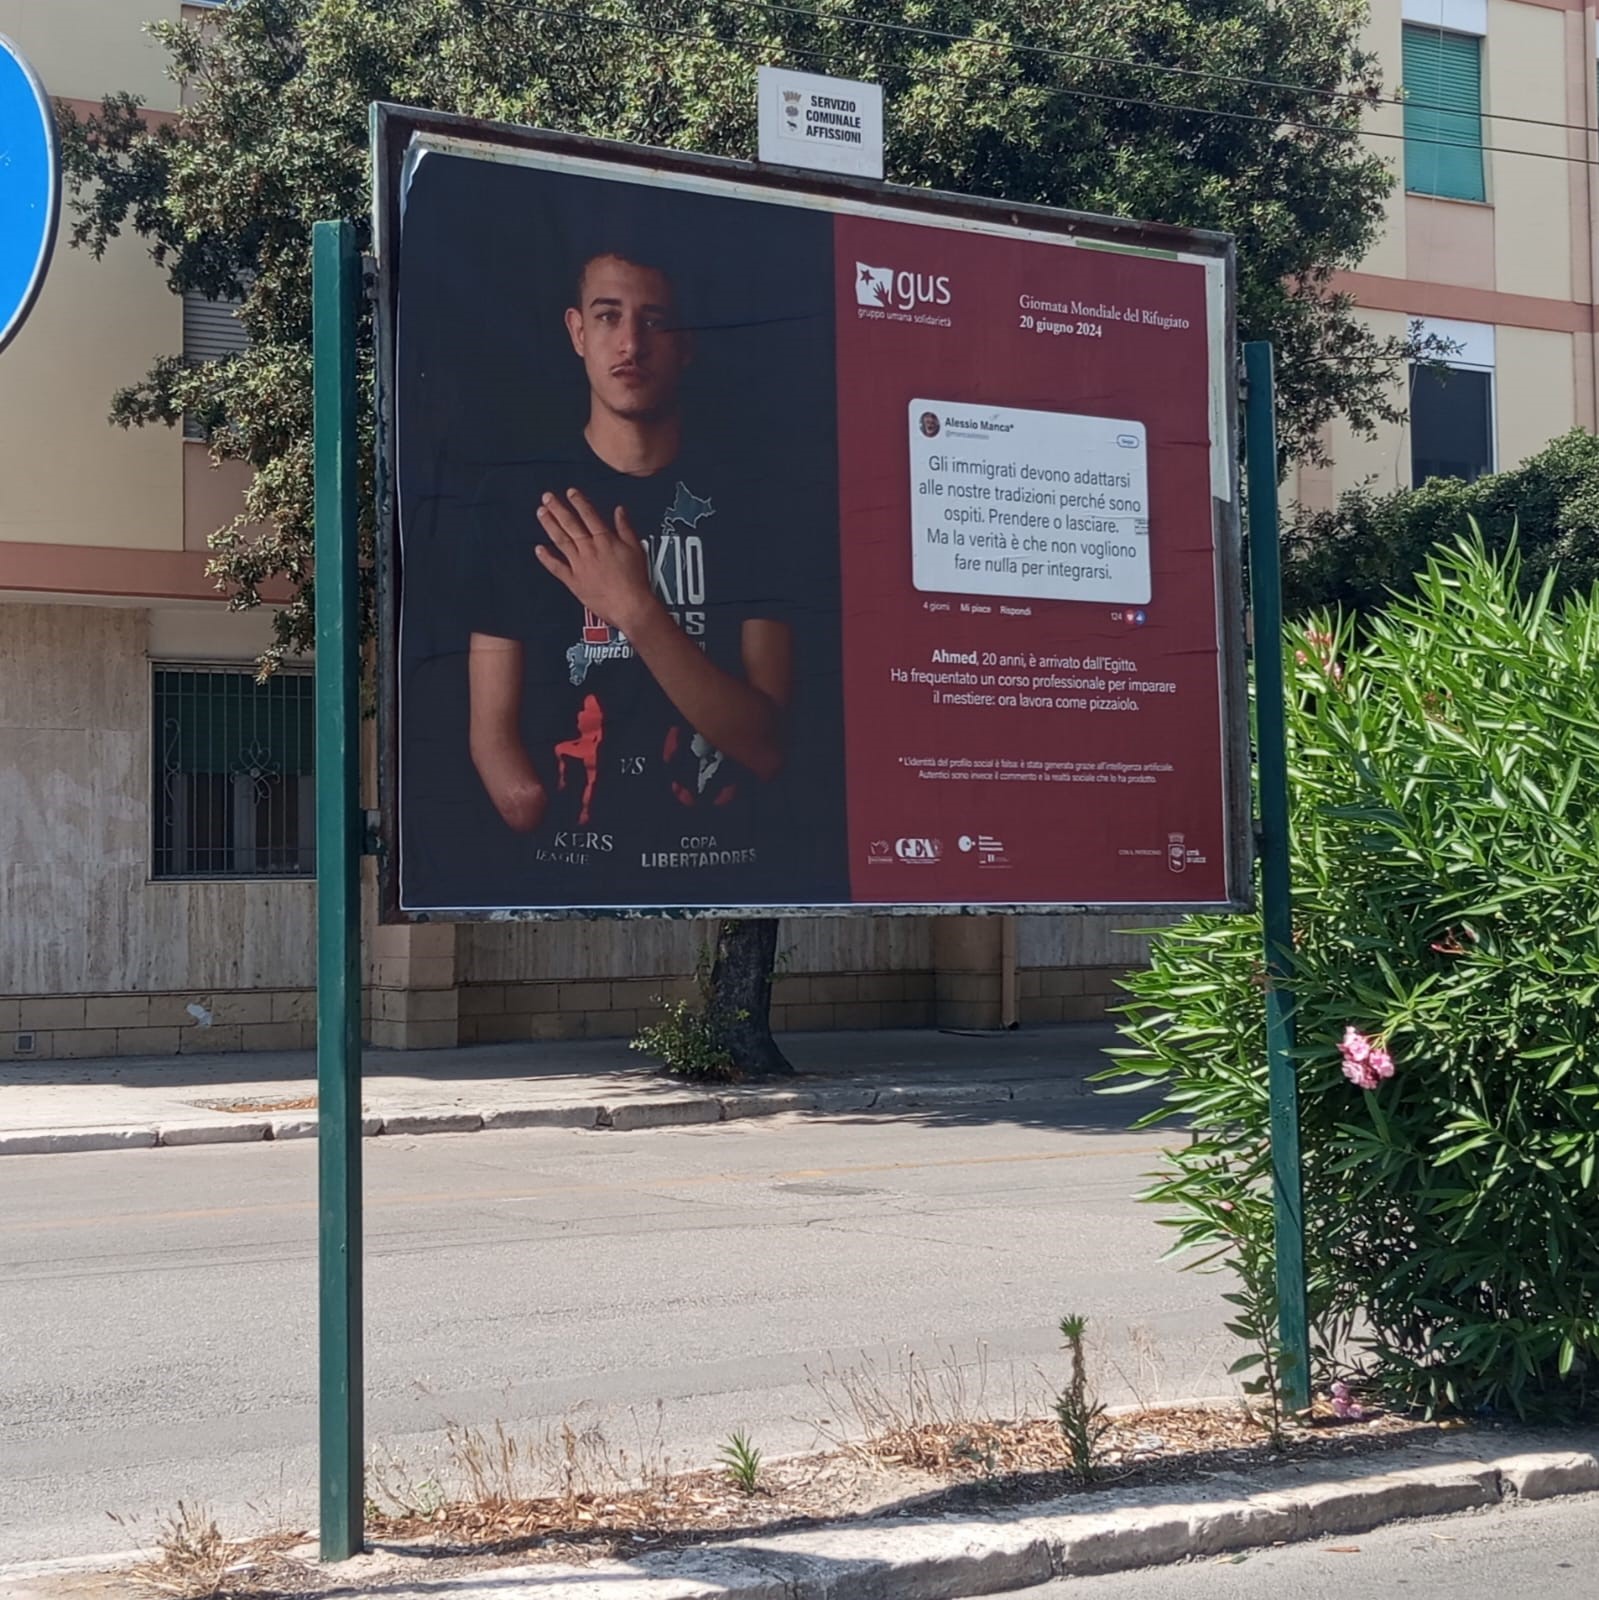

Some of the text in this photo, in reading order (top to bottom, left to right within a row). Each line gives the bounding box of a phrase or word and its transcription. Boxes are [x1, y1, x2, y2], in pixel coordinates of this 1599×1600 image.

[810, 95, 856, 112] SERVIZIO
[806, 110, 861, 128] COMUNALE
[806, 125, 861, 144] AFFISSIONI
[897, 271, 951, 310] gus
[858, 308, 885, 320] gruppo
[1019, 294, 1190, 329] Giornata Mondiale del Rifugiato
[1019, 315, 1103, 337] 20 giugno 2024
[945, 418, 978, 430] Alessio
[928, 455, 1130, 488] Gli immigrati devono adattarsi
[919, 479, 1141, 512] alle nostre tradizioni perché sono
[944, 506, 985, 525] ospiti.
[989, 508, 1050, 529] Prendere
[1053, 518, 1062, 529] o
[1066, 514, 1119, 533] lasciare.
[927, 528, 1137, 559] Ma la verità è che non vogliono
[955, 553, 1113, 581] fare nulla per integrarsi.
[922, 601, 928, 609] 4
[960, 603, 970, 612] Mi
[971, 604, 992, 614] piace
[1000, 605, 1032, 616] Rispondi
[1111, 612, 1122, 621] 124
[932, 649, 1138, 674] Ahmed, 20 anni, è arrivato dall'Egitto.
[891, 668, 1176, 694] Ha frequentato un corso professionale per imparare
[933, 690, 1139, 712] il mestiere: ora lavora come pizzaiolo.
[620, 756, 645, 775] VS
[680, 835, 717, 849] COPA
[641, 848, 757, 868] LIBERTADORES
